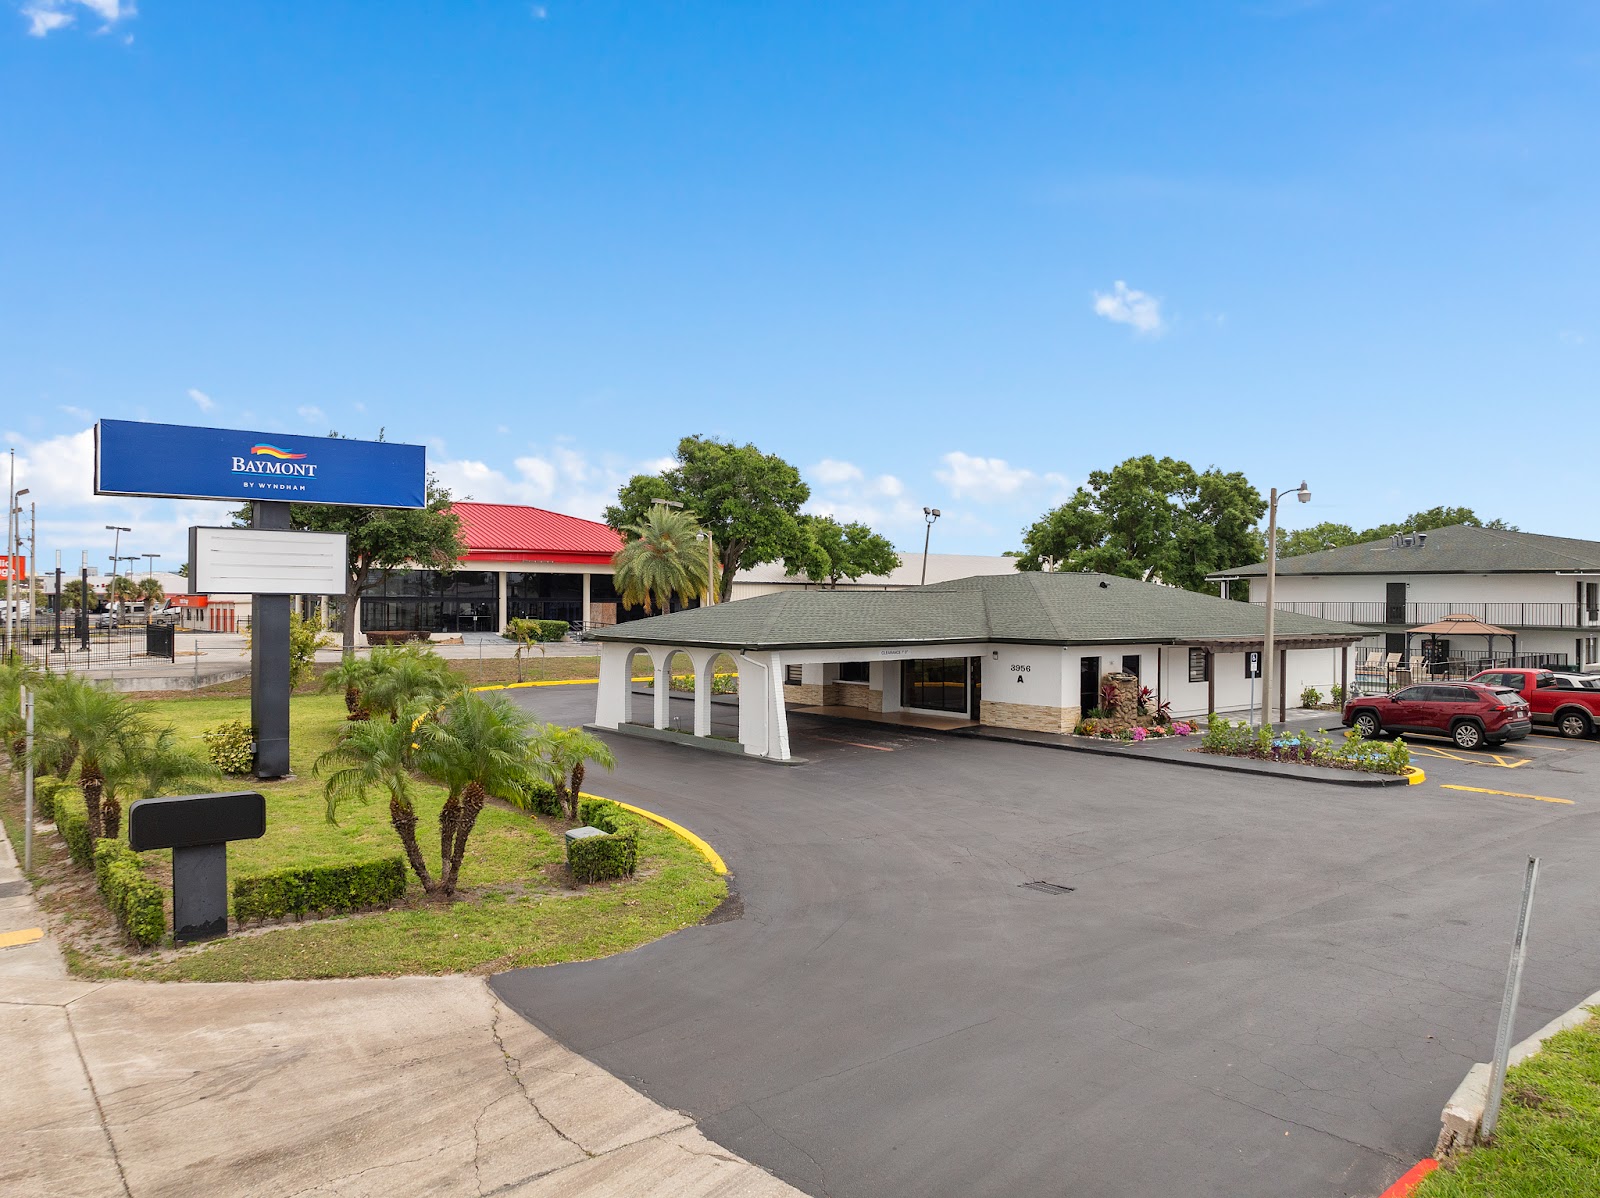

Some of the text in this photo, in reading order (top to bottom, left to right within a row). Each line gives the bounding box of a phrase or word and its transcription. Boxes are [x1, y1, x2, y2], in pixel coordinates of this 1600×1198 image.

[231, 456, 317, 477] BAYMONT
[258, 483, 306, 491] WYNDHAM
[1010, 664, 1031, 672] 3956
[1017, 674, 1024, 683] A
